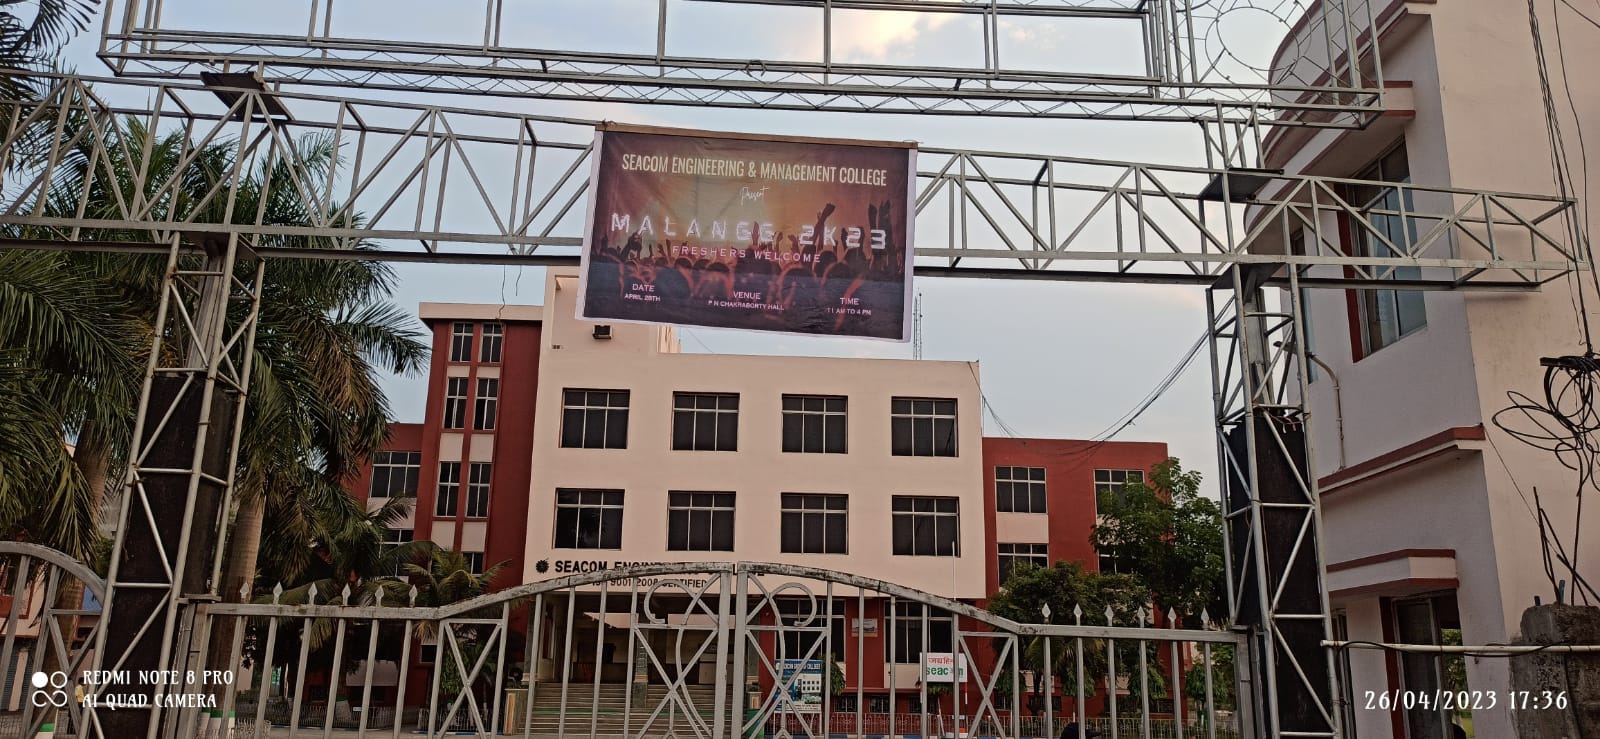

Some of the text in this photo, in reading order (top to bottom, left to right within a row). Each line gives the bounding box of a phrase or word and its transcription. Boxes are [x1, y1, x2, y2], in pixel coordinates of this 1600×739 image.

[622, 153, 887, 187] SEACOM ENGINEERING & MANAGEMENT COLLEGE
[799, 223, 886, 250] 2K23
[672, 245, 821, 262] FRESHERS WELCOME
[632, 283, 655, 292] DATE
[624, 293, 643, 301] APRIL
[733, 291, 761, 300] VENUE
[720, 301, 766, 309] CHAKRABORTY
[767, 303, 785, 311] HALL
[840, 297, 860, 306] TIME
[555, 560, 608, 573] SEACOM
